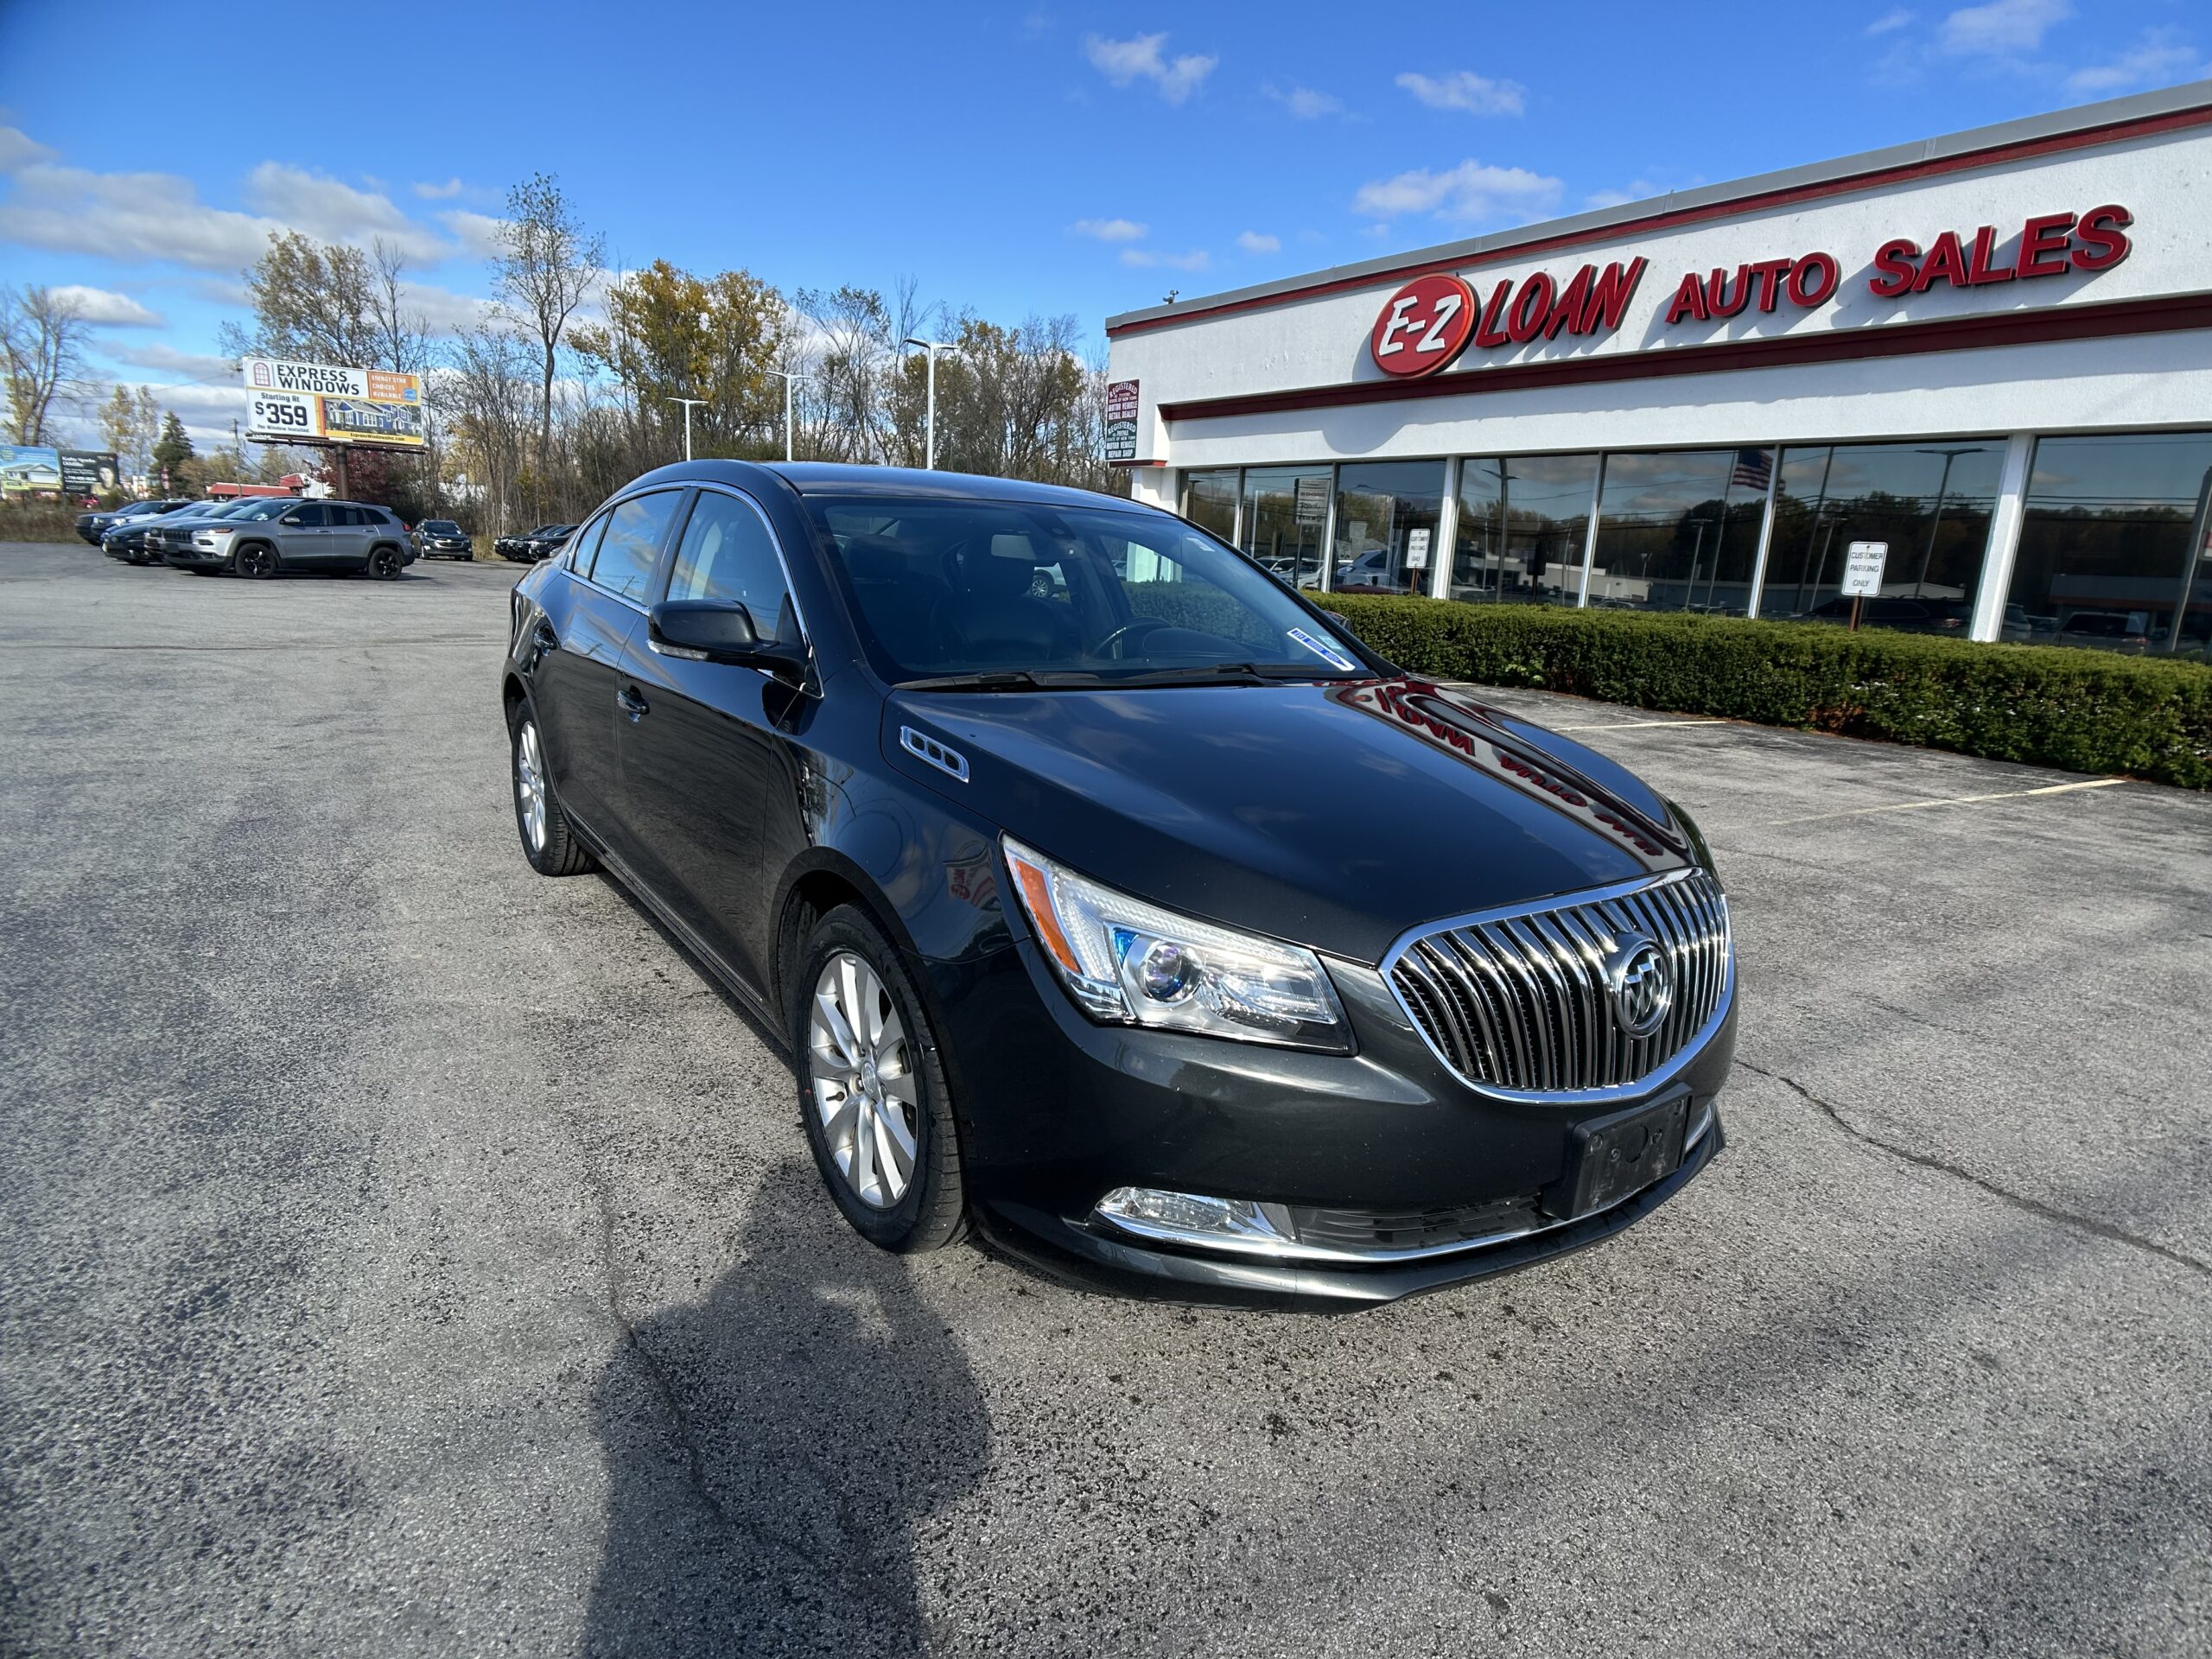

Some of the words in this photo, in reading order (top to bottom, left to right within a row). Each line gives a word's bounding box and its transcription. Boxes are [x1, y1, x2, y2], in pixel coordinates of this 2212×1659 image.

[1379, 294, 1462, 356] E-Z
[1475, 256, 1649, 348] LOAN
[1665, 251, 1841, 323] AUTO
[1869, 204, 2134, 297] SALES
[276, 364, 347, 383] EXPRESS
[278, 376, 359, 396] WINDOWS
[1109, 382, 1138, 398] REGISTERED
[261, 392, 290, 403] Starting
[255, 401, 308, 427] $359
[1108, 421, 1136, 435] REGISTERED
[1851, 551, 1884, 560] CUSTOMER
